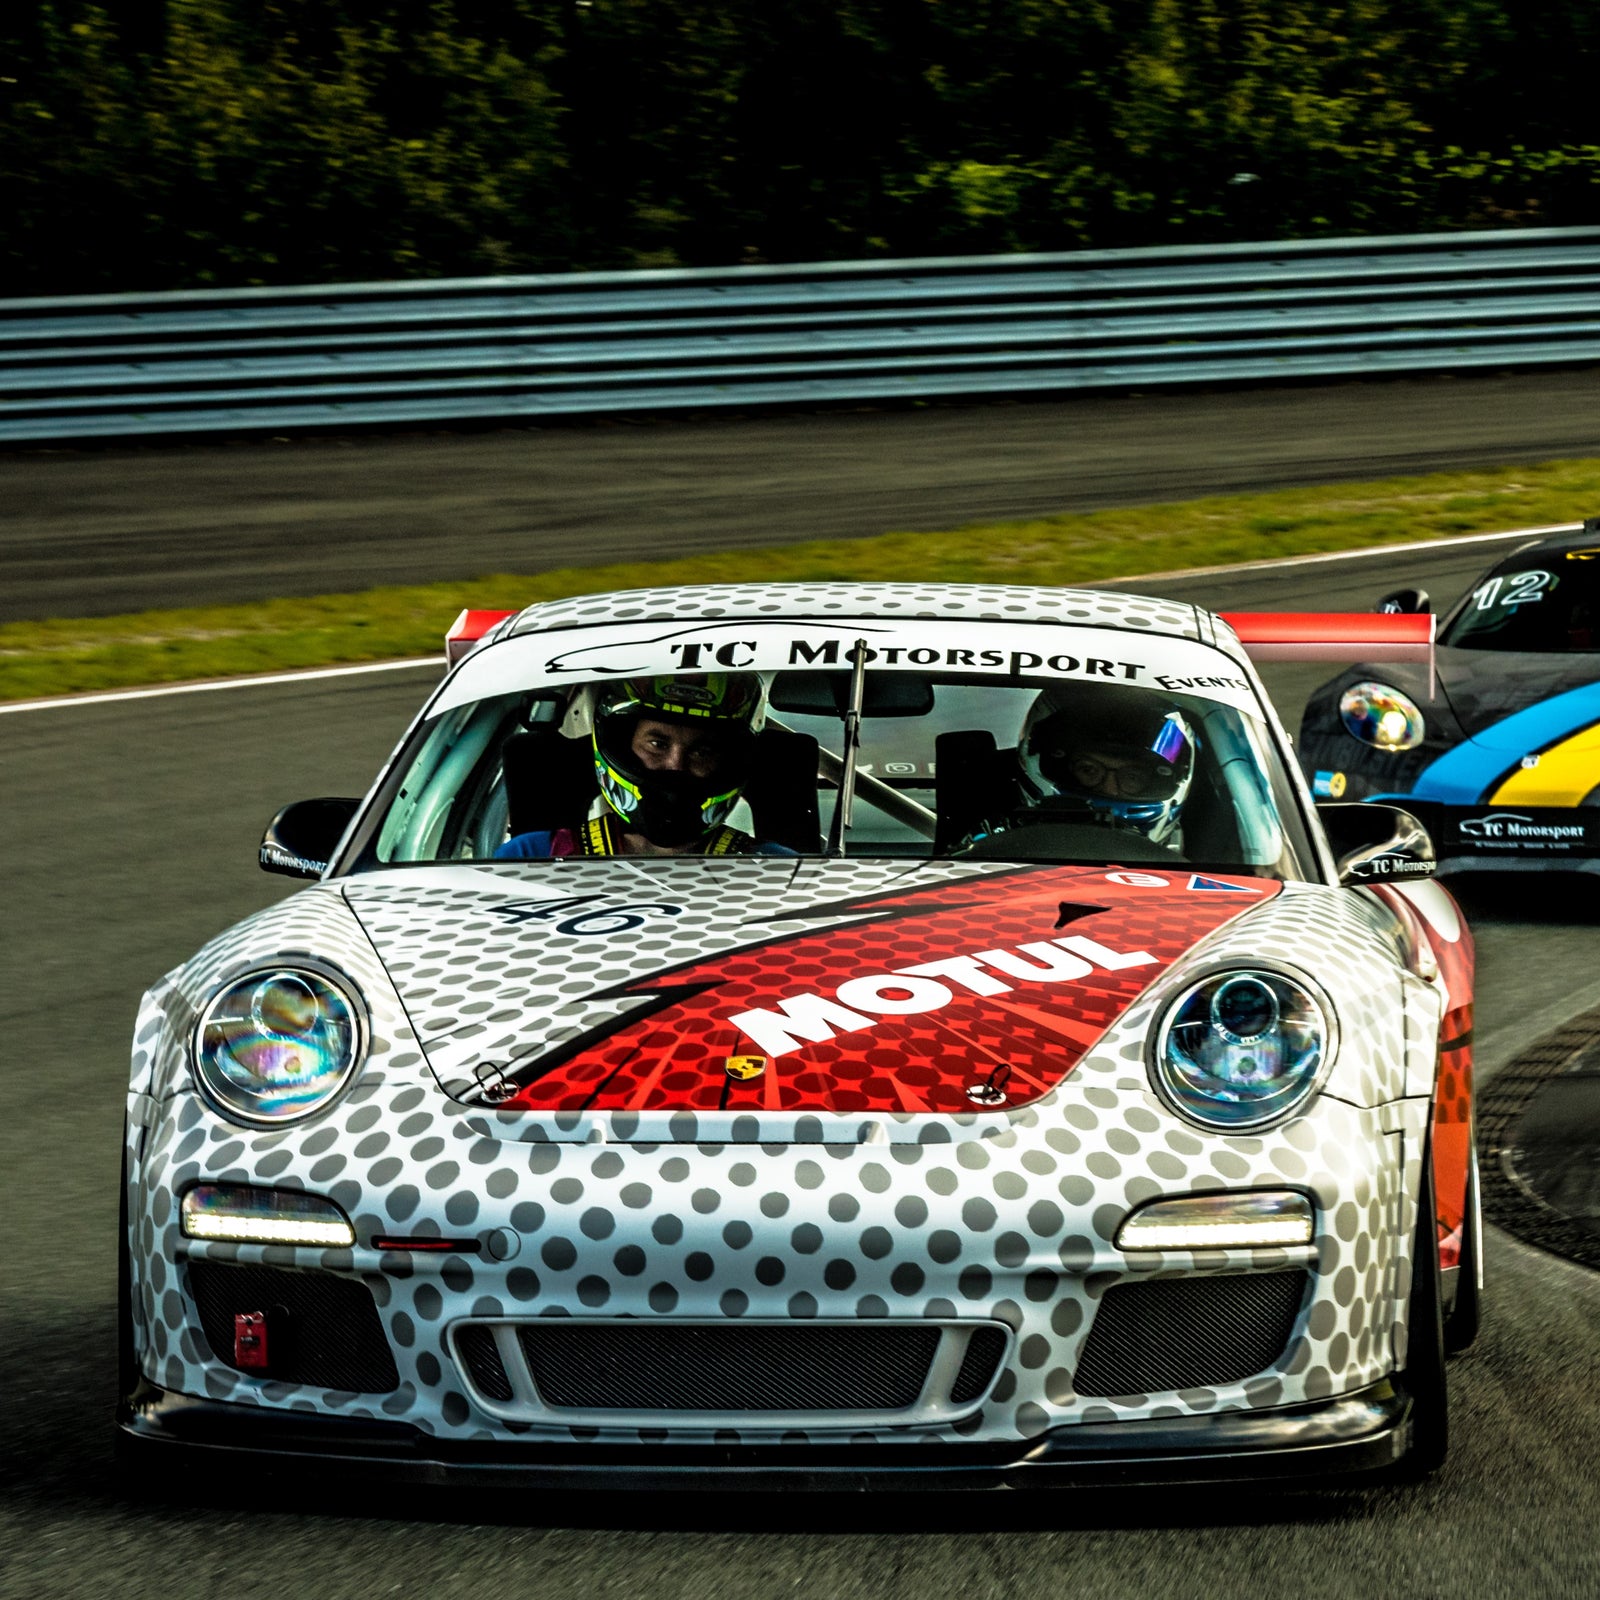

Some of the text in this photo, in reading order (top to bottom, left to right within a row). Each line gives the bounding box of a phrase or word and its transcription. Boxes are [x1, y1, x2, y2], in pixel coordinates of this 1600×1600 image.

[1473, 570, 1551, 611] 12
[670, 640, 758, 670] TC
[1154, 673, 1250, 693] EVENTS
[1482, 822, 1503, 837] TC
[260, 848, 271, 864] TC
[1371, 859, 1390, 874] TC
[485, 893, 684, 936] 46
[727, 934, 1161, 1059] MOTUL
